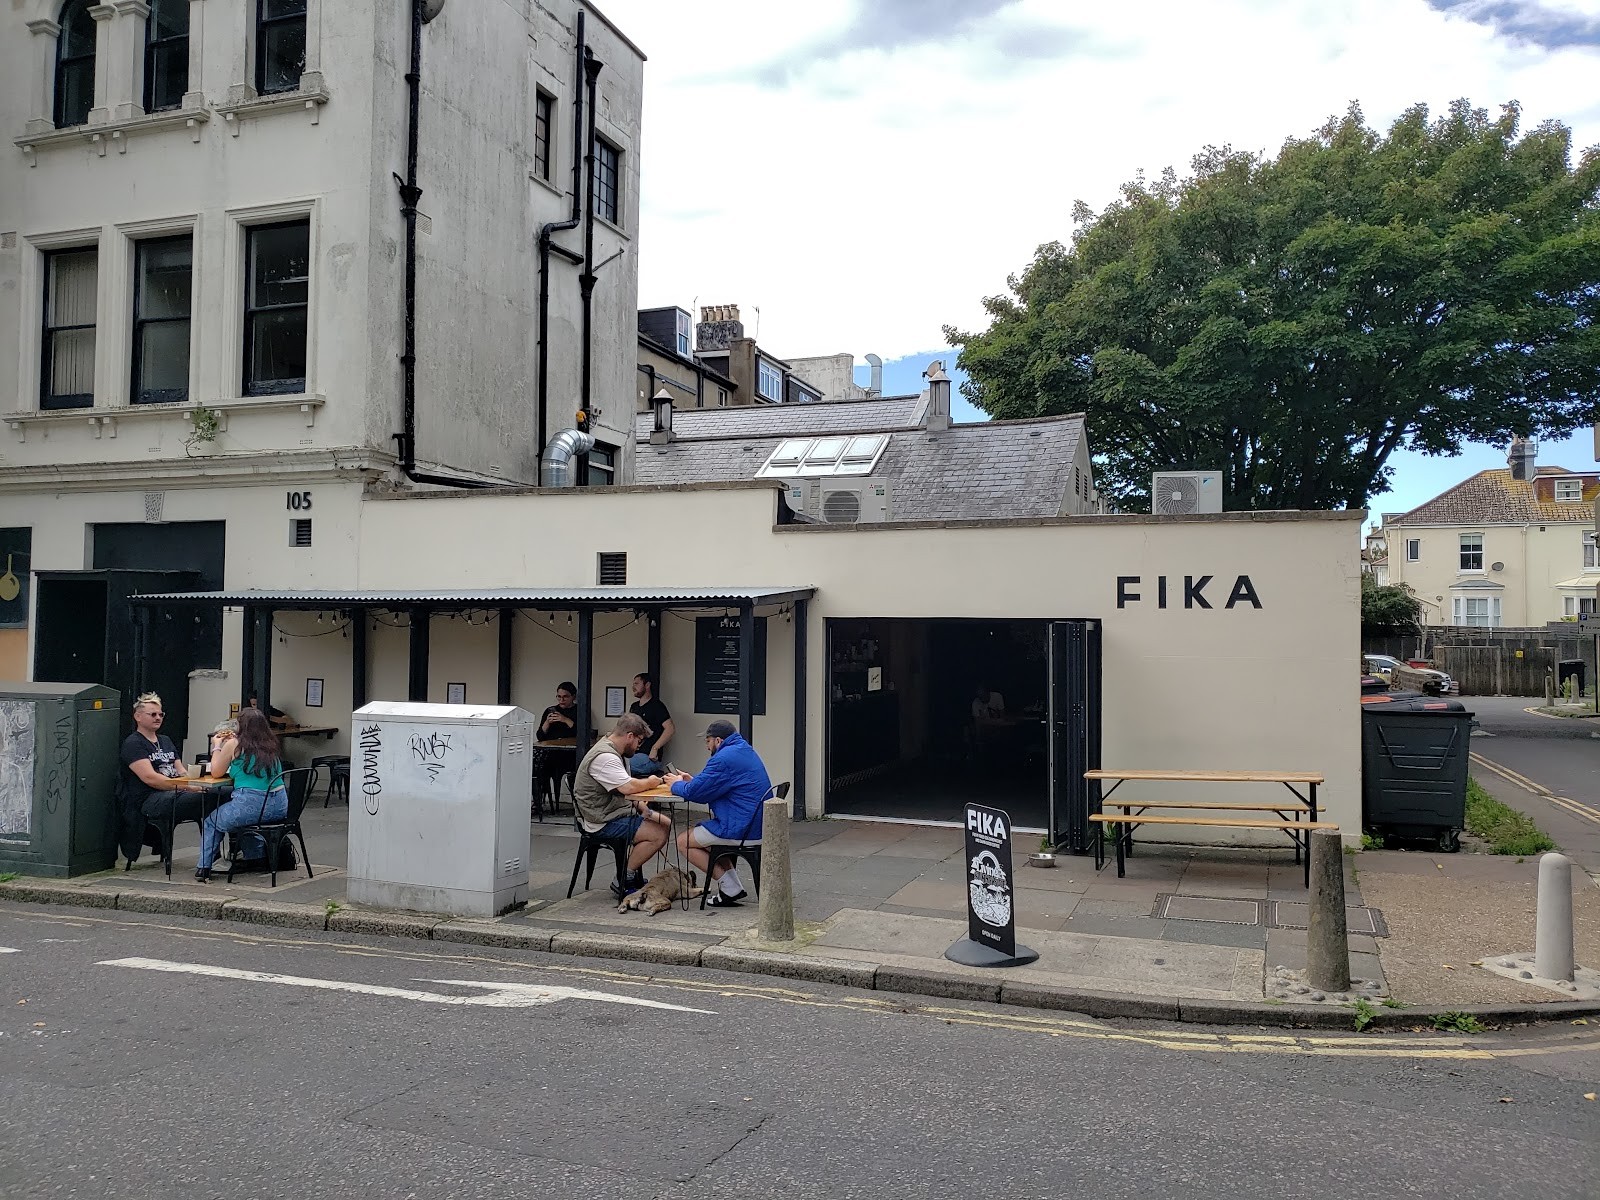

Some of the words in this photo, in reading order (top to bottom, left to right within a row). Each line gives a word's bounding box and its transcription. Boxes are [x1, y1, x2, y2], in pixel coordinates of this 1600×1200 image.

[286, 491, 312, 510] 105
[1117, 575, 1263, 609] FIKA
[967, 809, 1007, 840] FIKA
